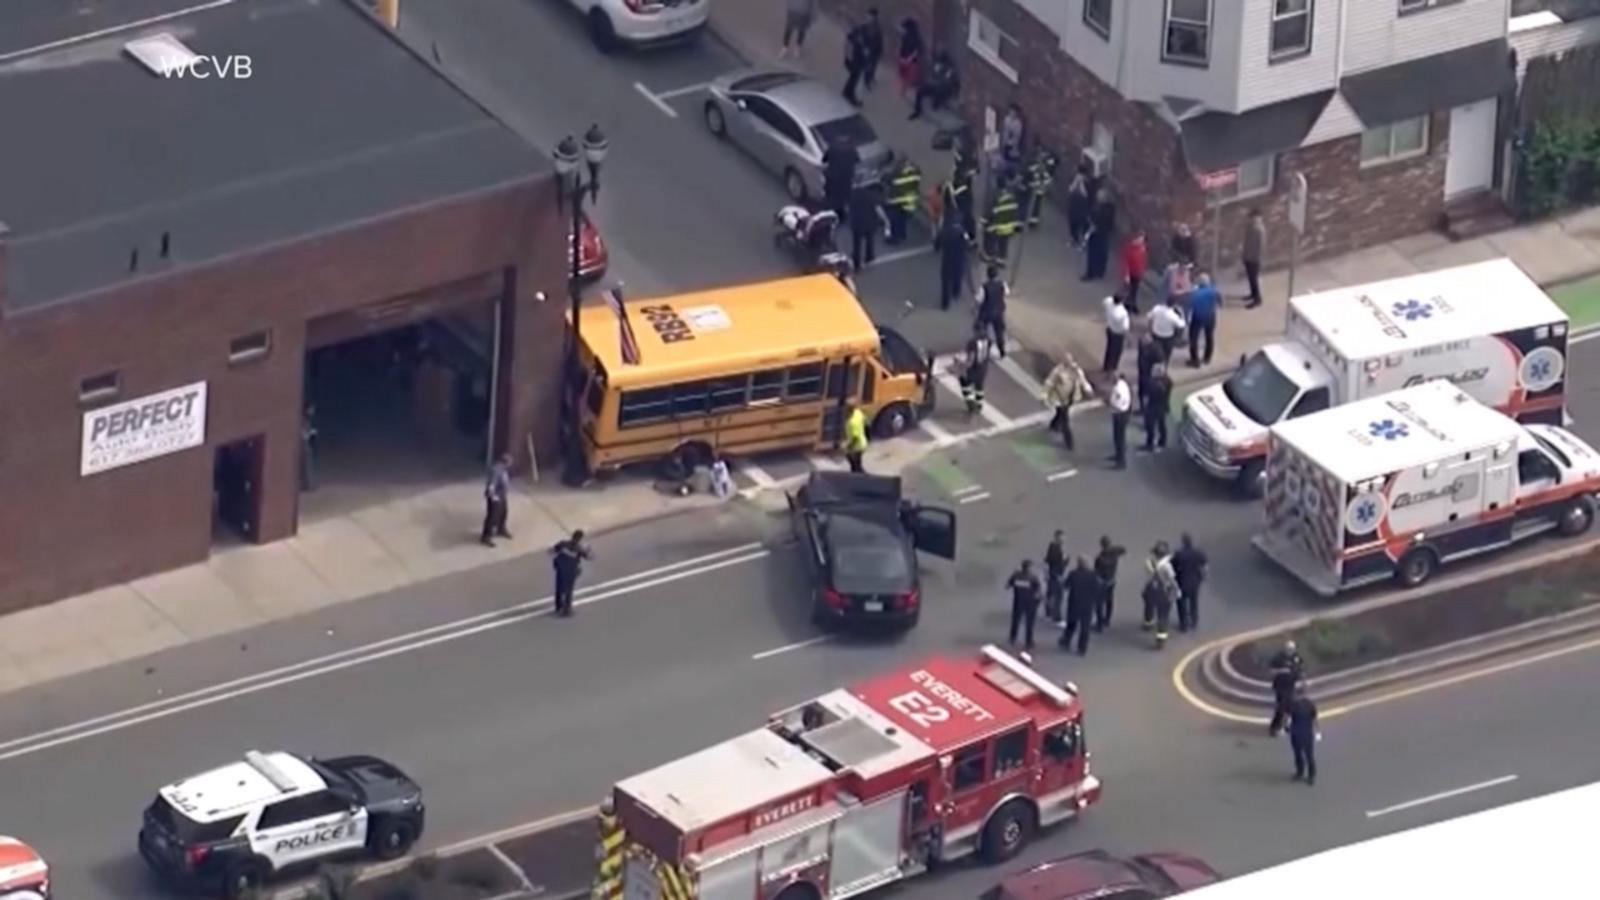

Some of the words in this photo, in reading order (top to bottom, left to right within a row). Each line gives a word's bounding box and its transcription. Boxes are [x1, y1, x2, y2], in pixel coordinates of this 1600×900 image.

[91, 391, 199, 442] PERFECT
[888, 690, 951, 729] E2
[909, 669, 995, 722] EVERETT
[755, 794, 814, 827] EVERETT
[275, 824, 344, 853] POLICE
